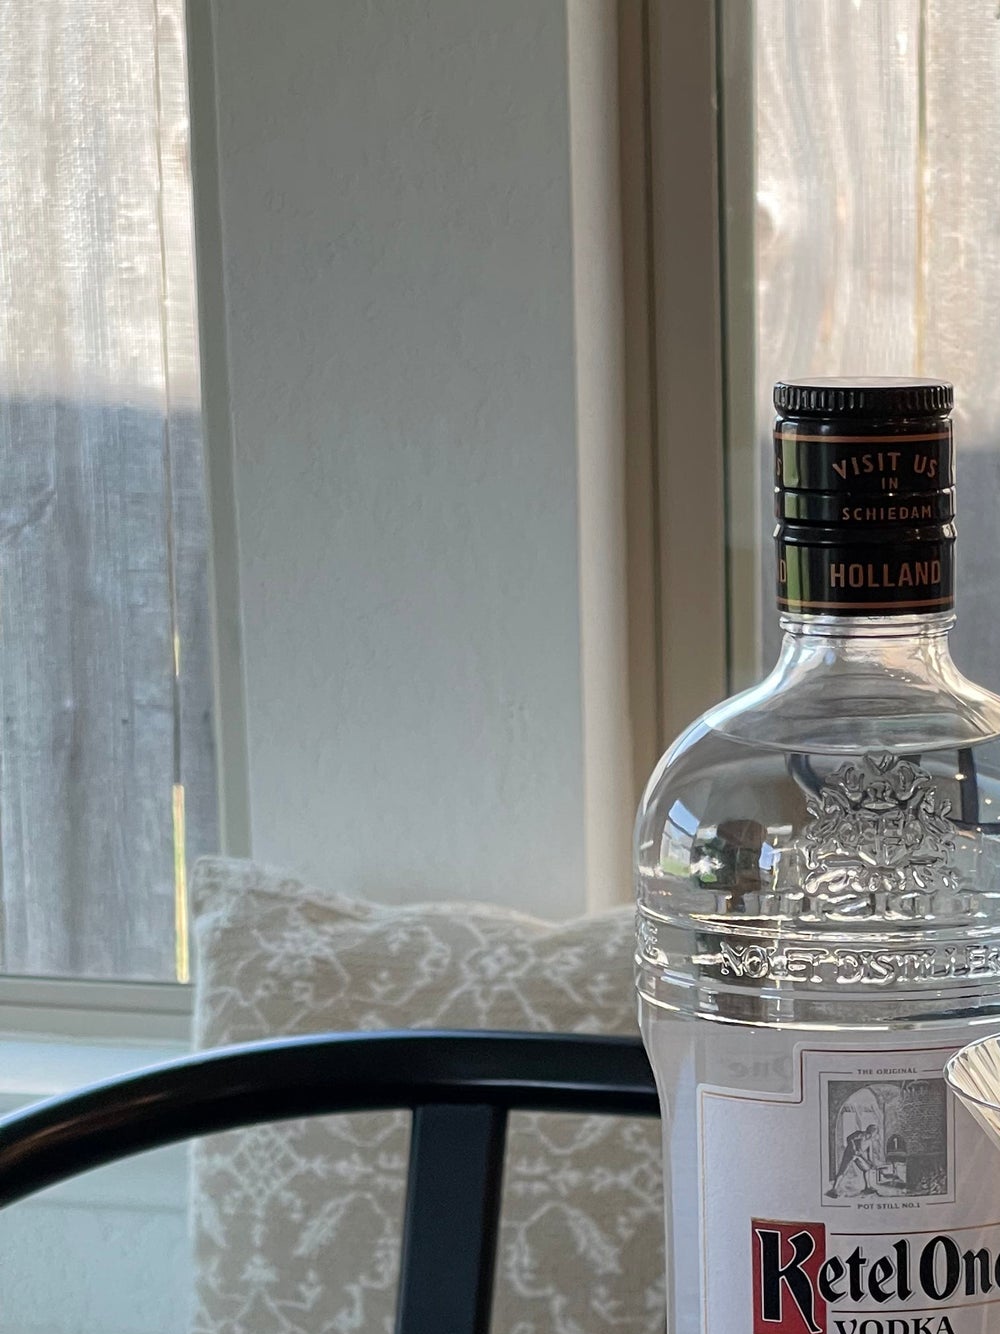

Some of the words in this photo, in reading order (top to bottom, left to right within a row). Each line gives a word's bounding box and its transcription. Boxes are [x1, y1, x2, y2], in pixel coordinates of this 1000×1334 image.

[831, 451, 901, 480] VISIT
[913, 453, 938, 479] US
[881, 476, 898, 490] IN
[842, 504, 932, 521] SCHIEDAM
[830, 559, 941, 588] HOLLAND
[755, 1229, 916, 1334] Ketel
